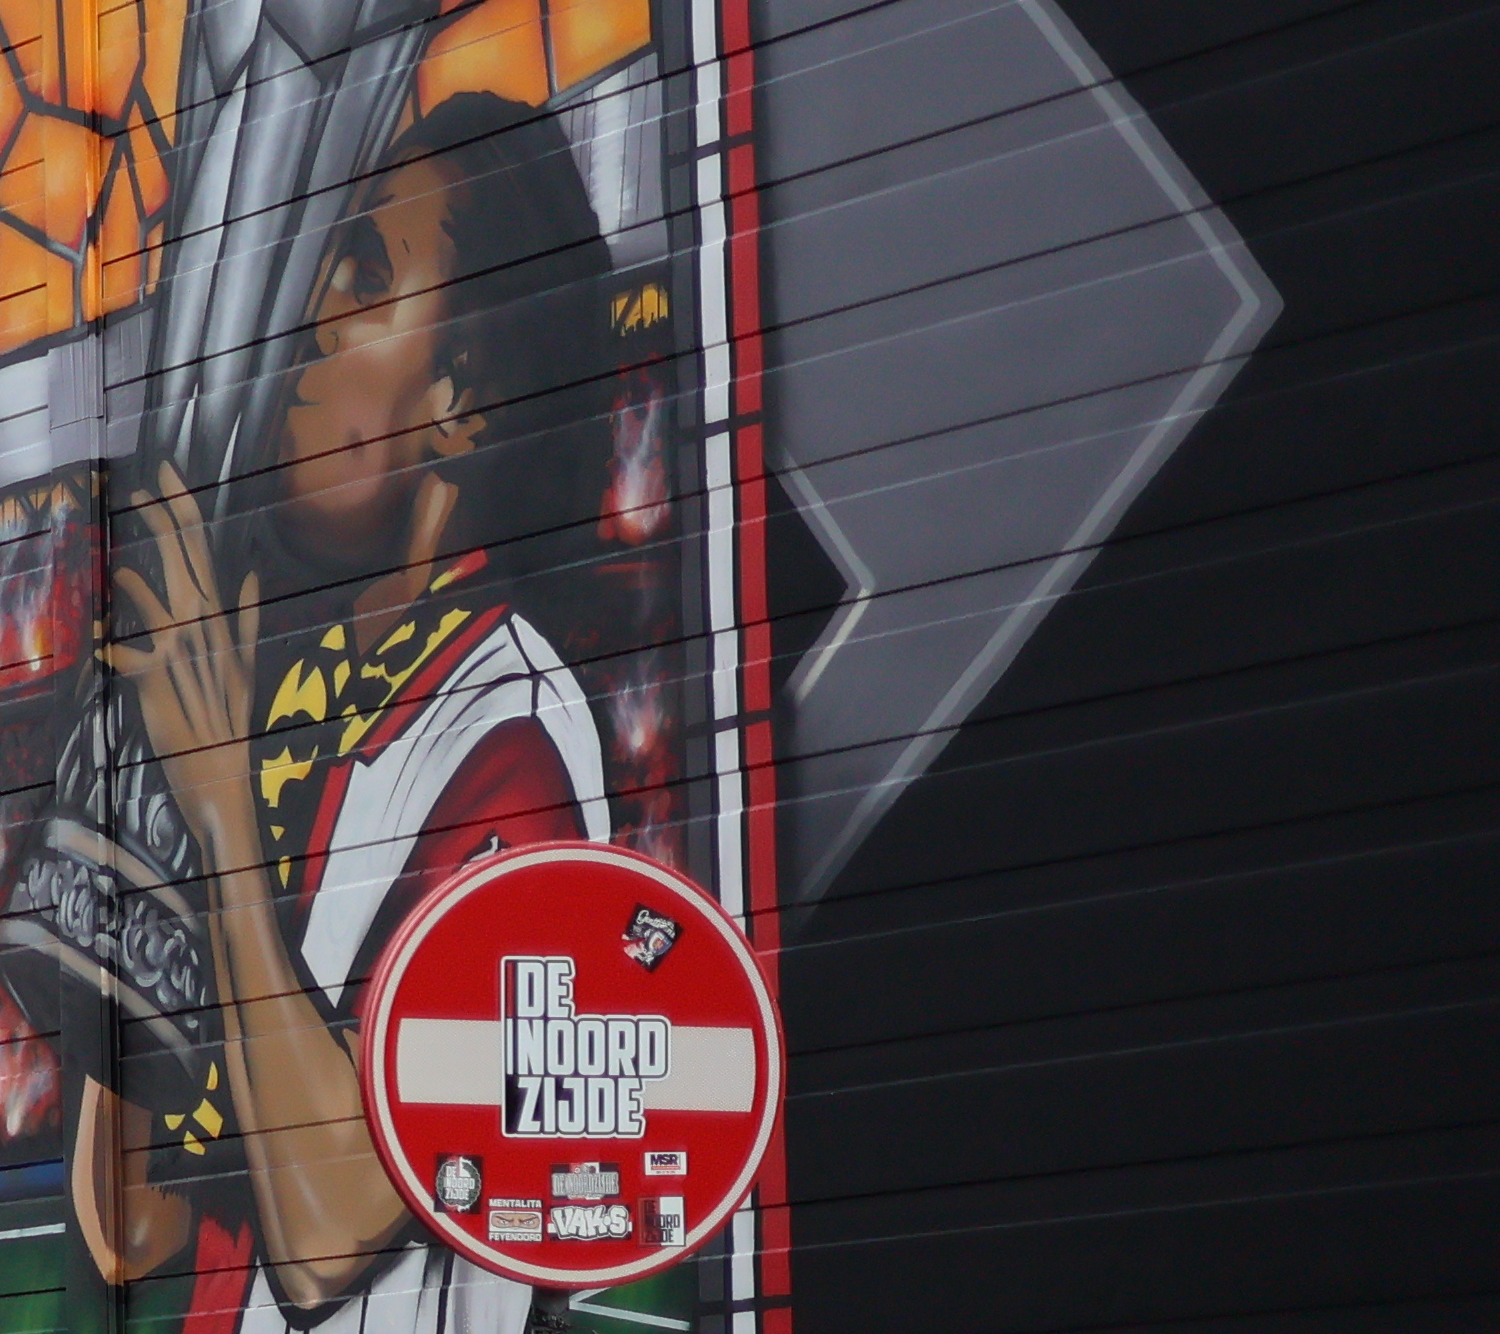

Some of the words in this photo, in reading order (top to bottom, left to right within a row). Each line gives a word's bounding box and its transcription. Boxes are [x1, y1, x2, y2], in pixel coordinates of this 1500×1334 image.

[517, 961, 572, 1018] DE
[516, 1019, 669, 1076] NOORD
[516, 1078, 643, 1134] ZIJDE
[650, 1153, 679, 1166] MSR
[489, 1198, 542, 1208] MENTALITA
